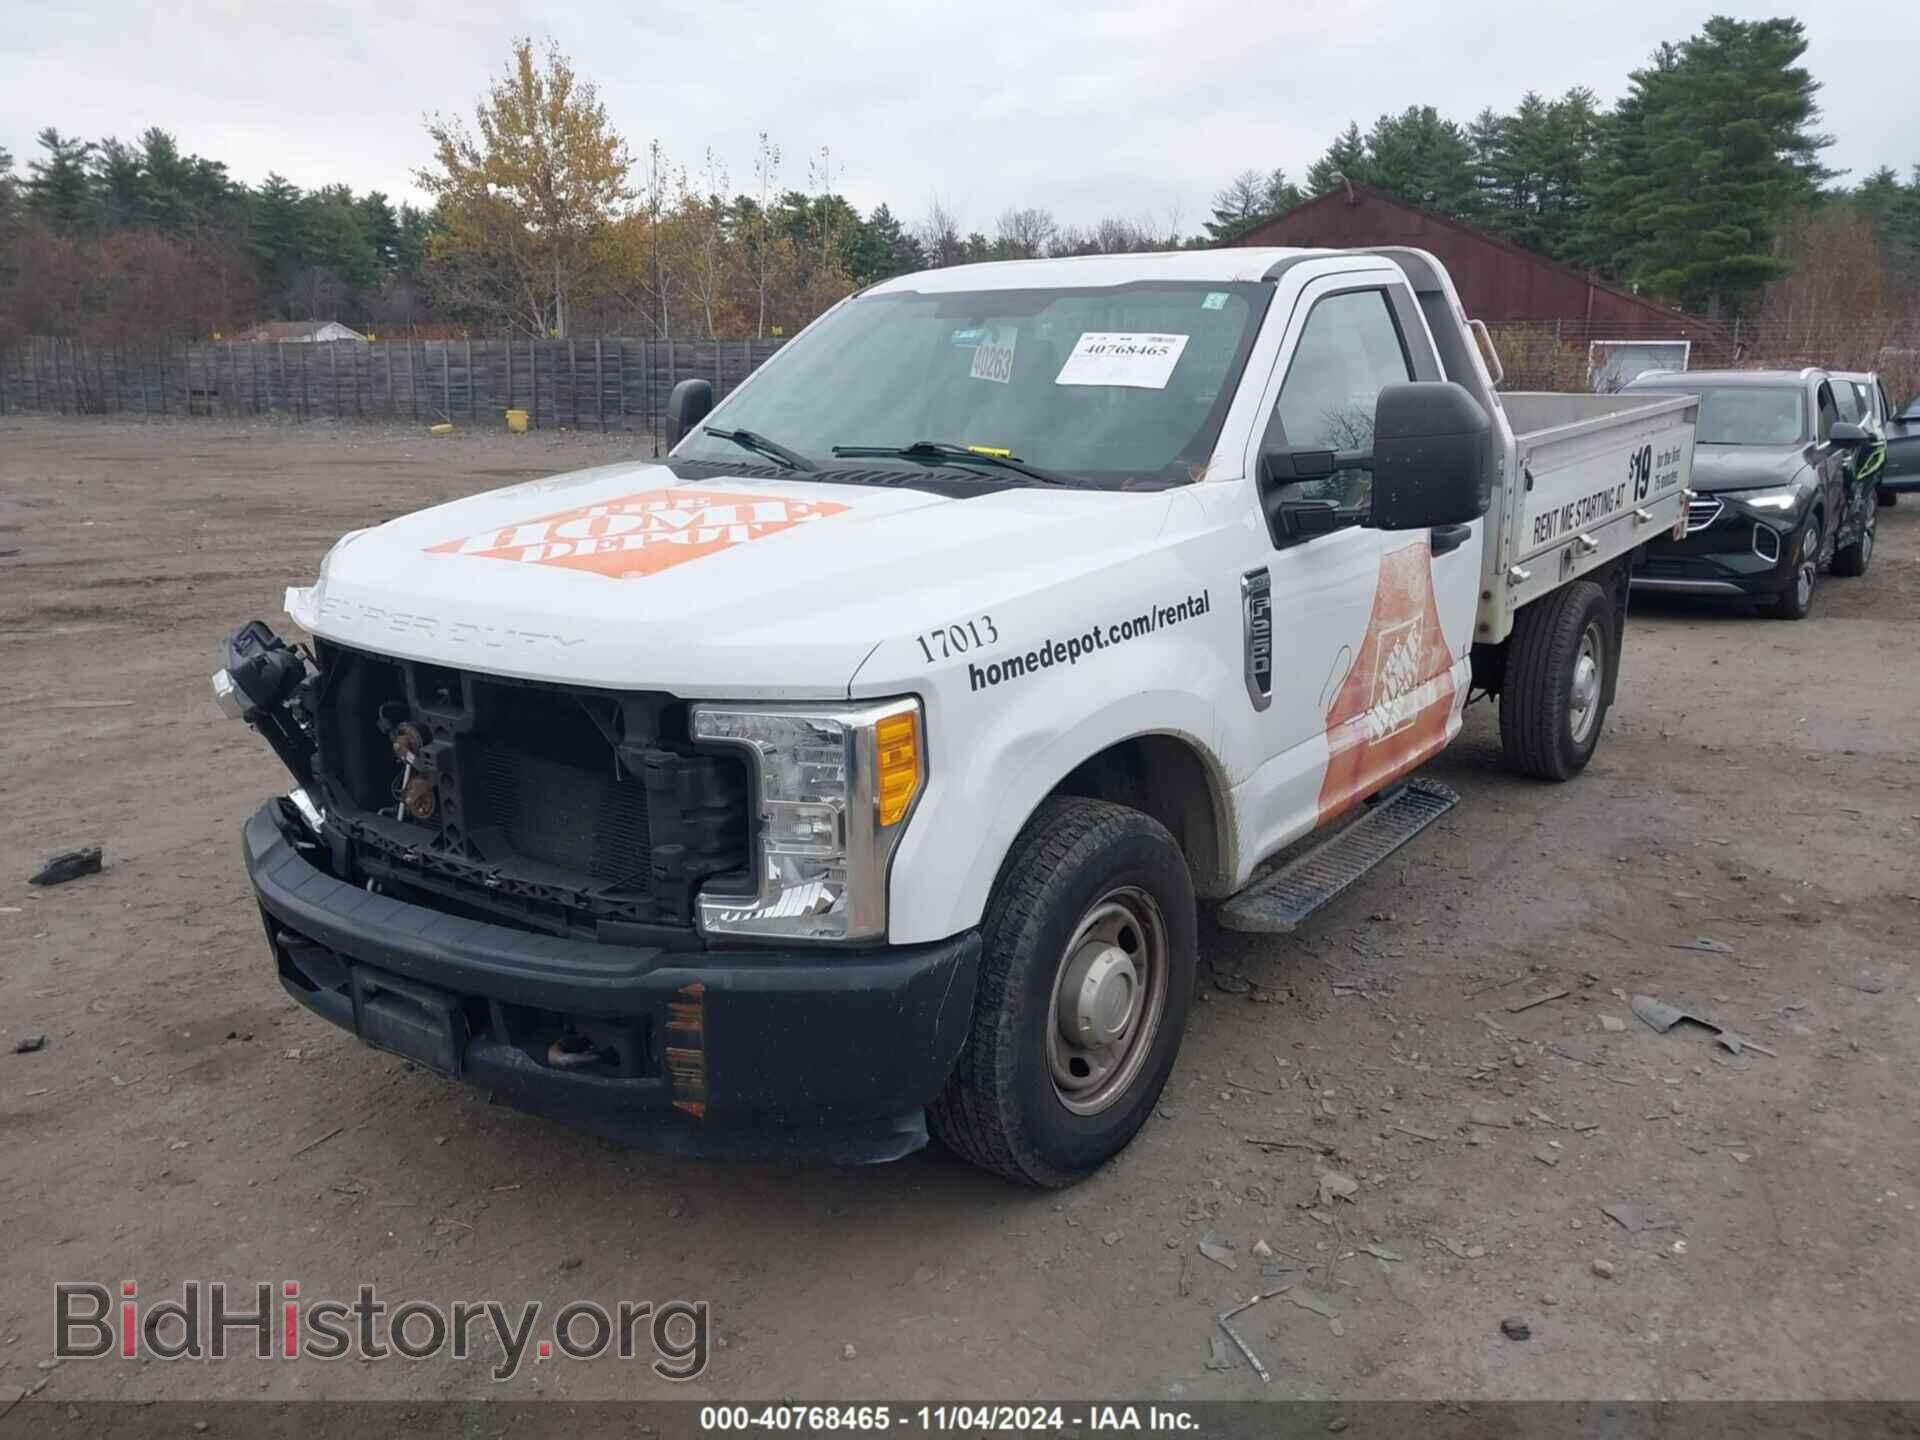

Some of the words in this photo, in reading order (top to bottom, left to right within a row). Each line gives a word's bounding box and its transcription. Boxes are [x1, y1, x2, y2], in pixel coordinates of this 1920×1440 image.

[1083, 343, 1169, 356] 40768465
[1533, 508, 1559, 545] RENT
[1560, 504, 1575, 534] ME
[1574, 485, 1615, 526] STARTING
[1615, 482, 1626, 513] AT
[1629, 444, 1652, 501] $19
[458, 499, 824, 554] HOME
[520, 524, 766, 563] DEPOT
[318, 597, 439, 637] SUPER
[447, 622, 586, 648] DUTY
[916, 615, 999, 664] 17013
[968, 589, 1211, 692] homedepot.com/rental
